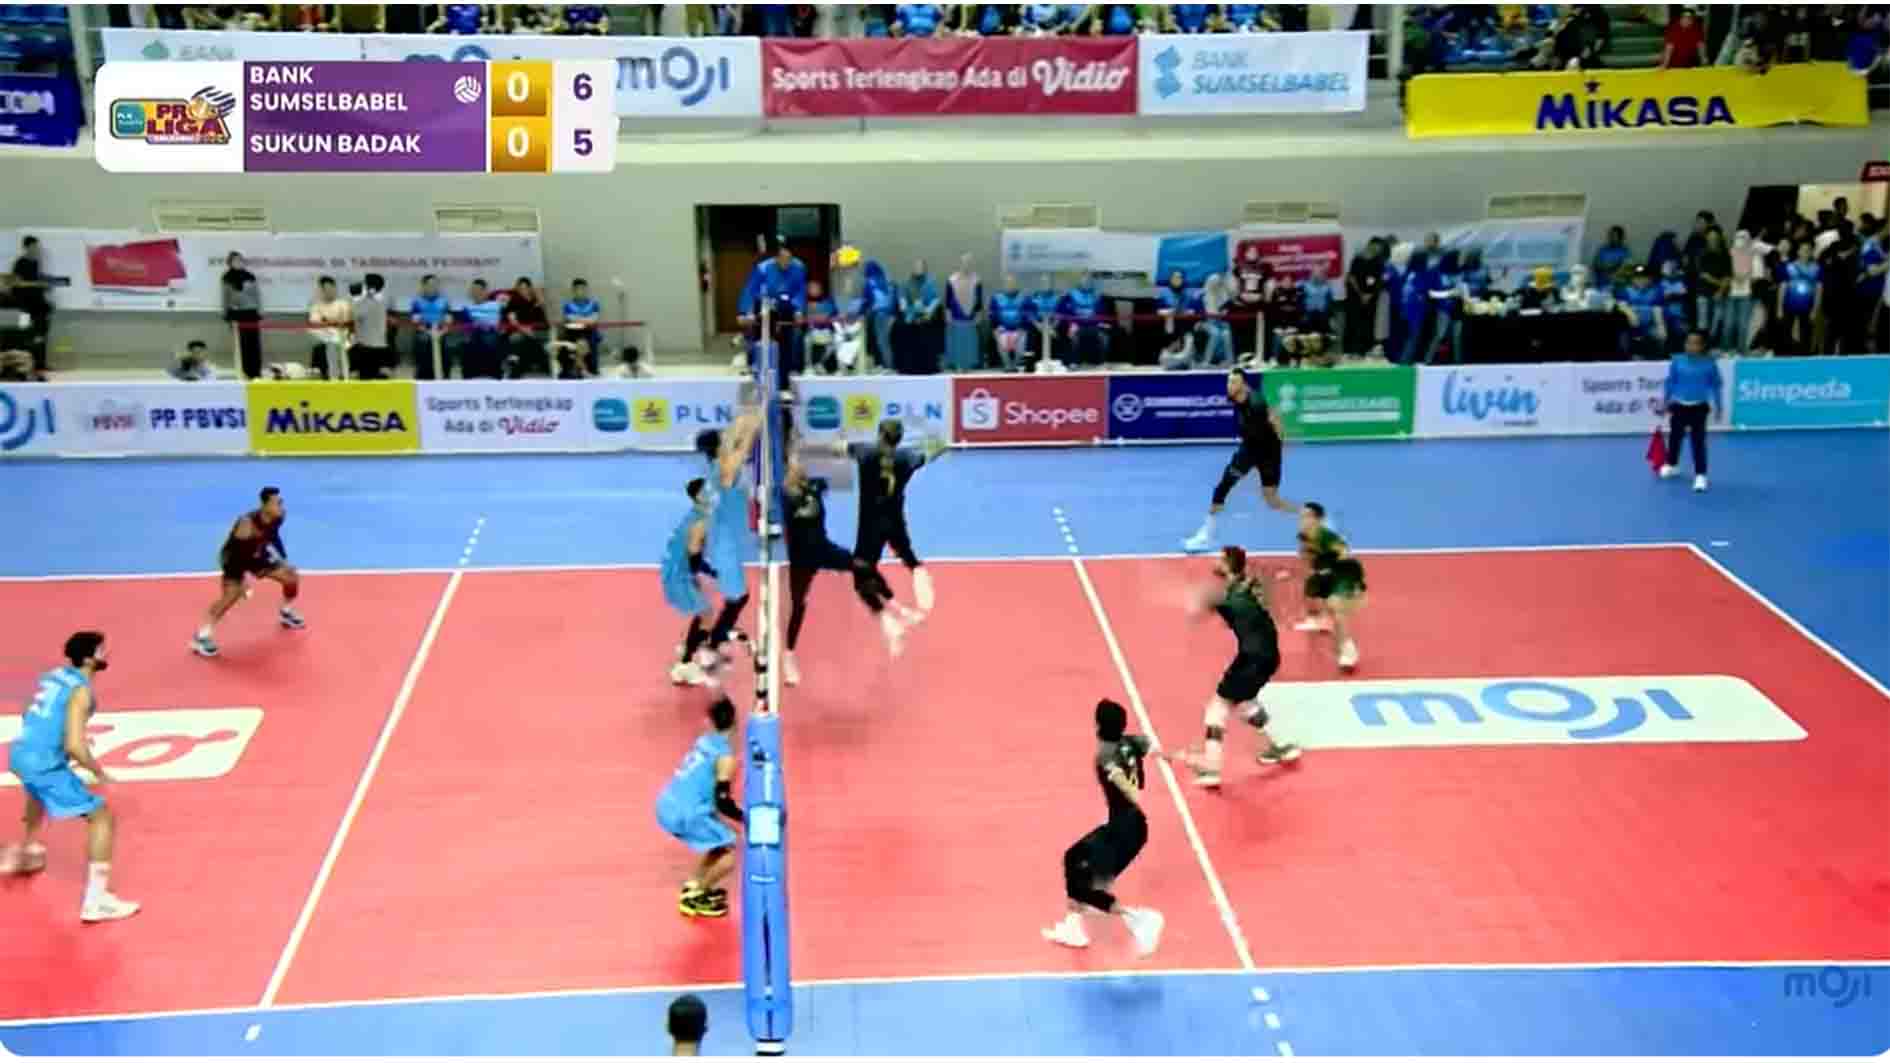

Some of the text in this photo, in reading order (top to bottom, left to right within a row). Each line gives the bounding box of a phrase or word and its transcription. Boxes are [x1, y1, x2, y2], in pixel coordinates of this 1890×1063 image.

[772, 56, 1130, 95] Sports Terlengkap Ada di Vidio
[1738, 376, 1851, 406] Simpeda
[427, 396, 480, 413] Sports
[675, 404, 732, 423] PLN
[1004, 401, 1100, 428] Shopee
[183, 406, 246, 430] PBVSI
[498, 416, 560, 435] Vidio
